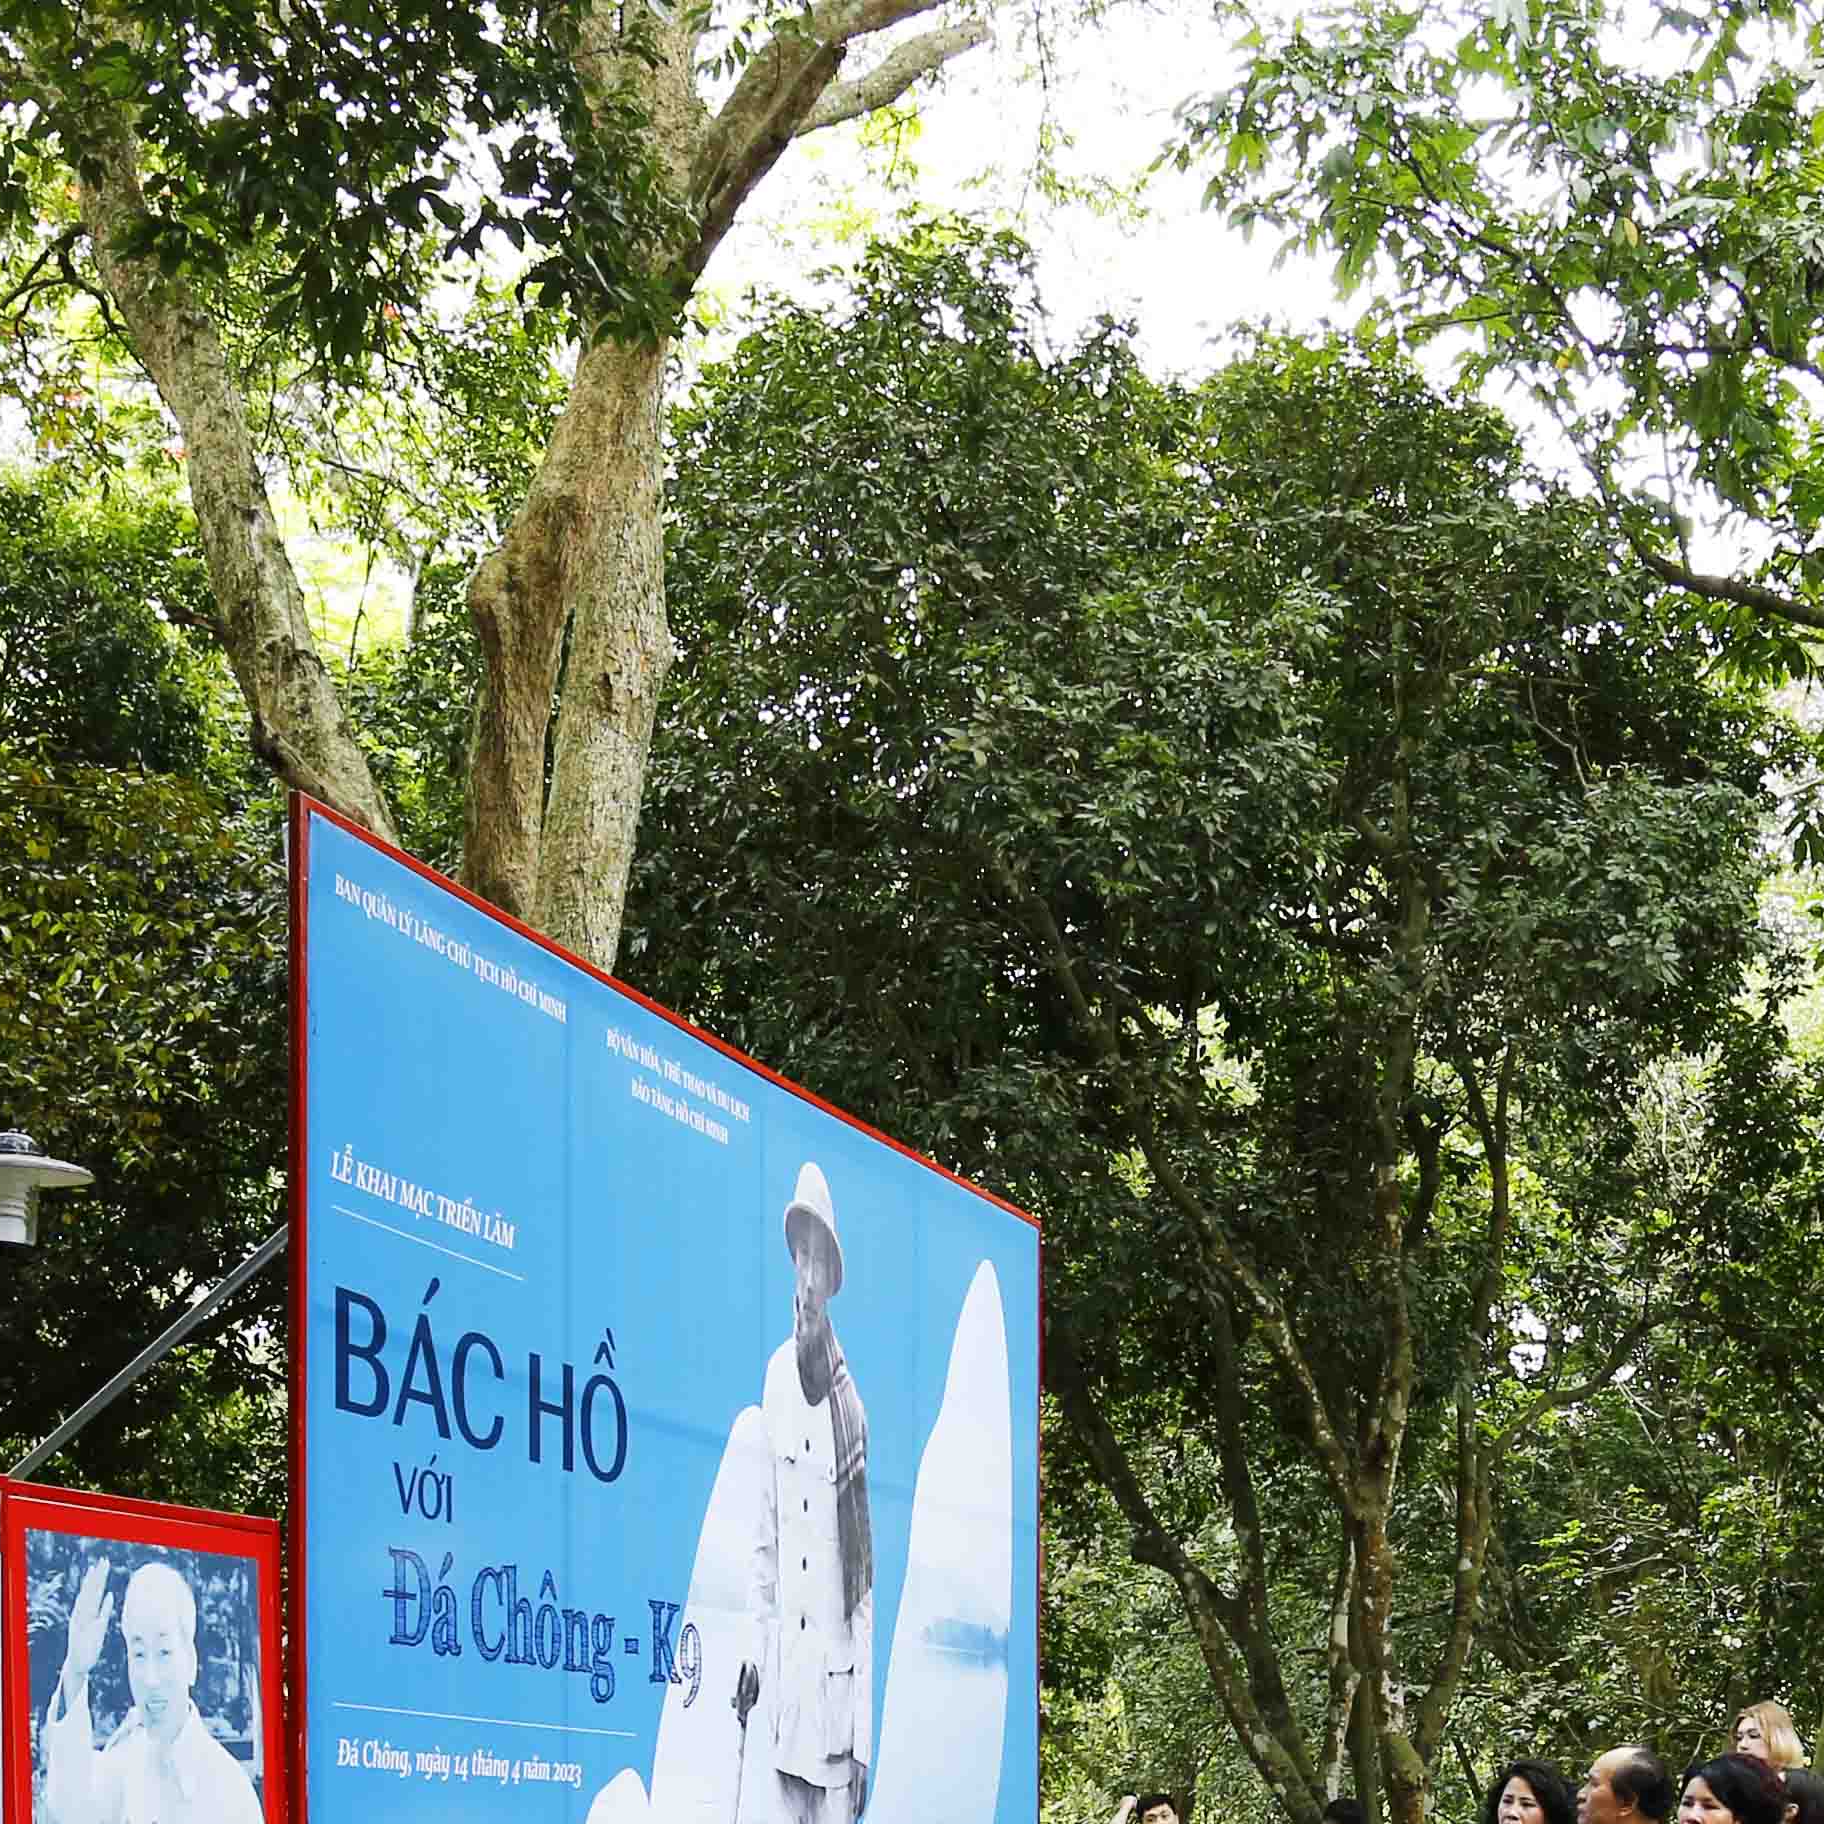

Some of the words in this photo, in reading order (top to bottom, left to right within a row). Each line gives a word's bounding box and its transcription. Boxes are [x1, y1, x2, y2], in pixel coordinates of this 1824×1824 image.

[336, 873, 361, 905] BAN
[363, 890, 397, 928] QUẢN
[399, 909, 413, 937] LÝ
[415, 920, 445, 955] LĂNG
[447, 940, 471, 969] CHỦ
[473, 953, 499, 985] TỊCH
[500, 965, 516, 995] HỒ
[518, 983, 537, 1006] CHÍ
[540, 990, 567, 1024] MINH
[331, 1144, 353, 1184] LỄ
[355, 1161, 398, 1202] KHAI
[399, 1180, 435, 1220] MẠC
[436, 1195, 482, 1236] TRIỂN
[484, 1213, 515, 1249] LÃM
[335, 1277, 505, 1450] BÁC
[528, 1327, 628, 1484] HỒ
[393, 1453, 453, 1523] VỚI
[384, 1545, 462, 1657] Đá
[471, 1565, 614, 1703] Chông
[648, 1599, 701, 1708] K9
[337, 1738, 359, 1767] Đá
[362, 1739, 412, 1778] Chông,
[416, 1746, 450, 1781] ngày
[454, 1754, 468, 1781] 14
[471, 1749, 509, 1785] tháng
[512, 1760, 520, 1784] 4
[523, 1755, 550, 1781] năm
[553, 1762, 582, 1788] 2023
